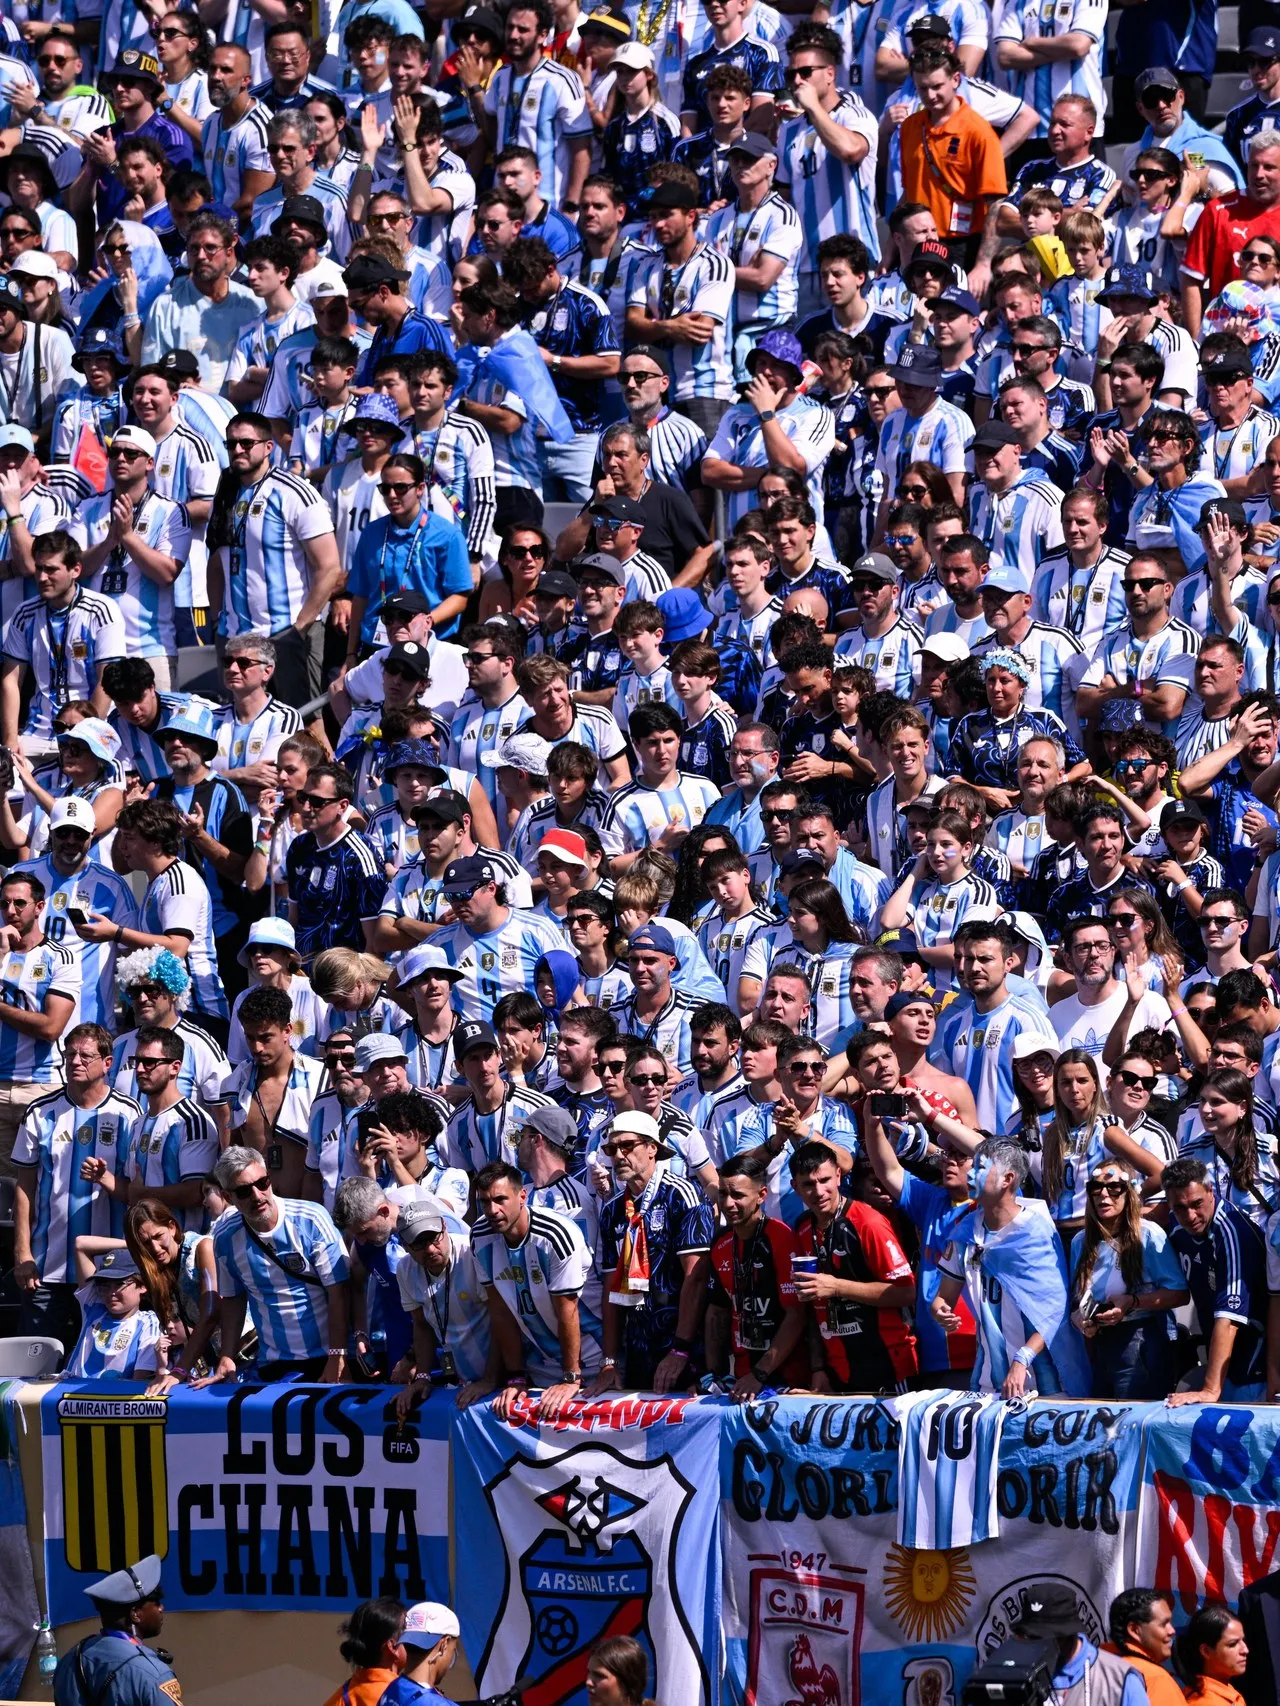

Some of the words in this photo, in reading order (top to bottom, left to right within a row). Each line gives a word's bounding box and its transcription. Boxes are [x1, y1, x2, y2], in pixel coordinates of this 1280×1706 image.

[922, 240, 948, 260] INDIO
[1136, 238, 1158, 263] 10
[44, 915, 67, 943] 10
[481, 977, 498, 1004] 4
[464, 1024, 482, 1040] B
[671, 1080, 695, 1097] ARDO
[980, 1274, 1003, 1304] 10
[63, 1401, 121, 1416] ALMIRANTE
[123, 1401, 164, 1416] BROWN
[223, 1385, 384, 1478] LOS
[790, 1403, 899, 1451] JUR
[1024, 1407, 1132, 1448] CON
[926, 1401, 983, 1462] 10
[390, 1442, 414, 1455] FIFA
[732, 1438, 898, 1522] GLORI
[998, 1448, 1120, 1535] ORIR
[177, 1483, 426, 1601] CHANA
[780, 1549, 828, 1571] 1947
[537, 1571, 604, 1592] ARSENAL
[608, 1575, 636, 1592] F.C.
